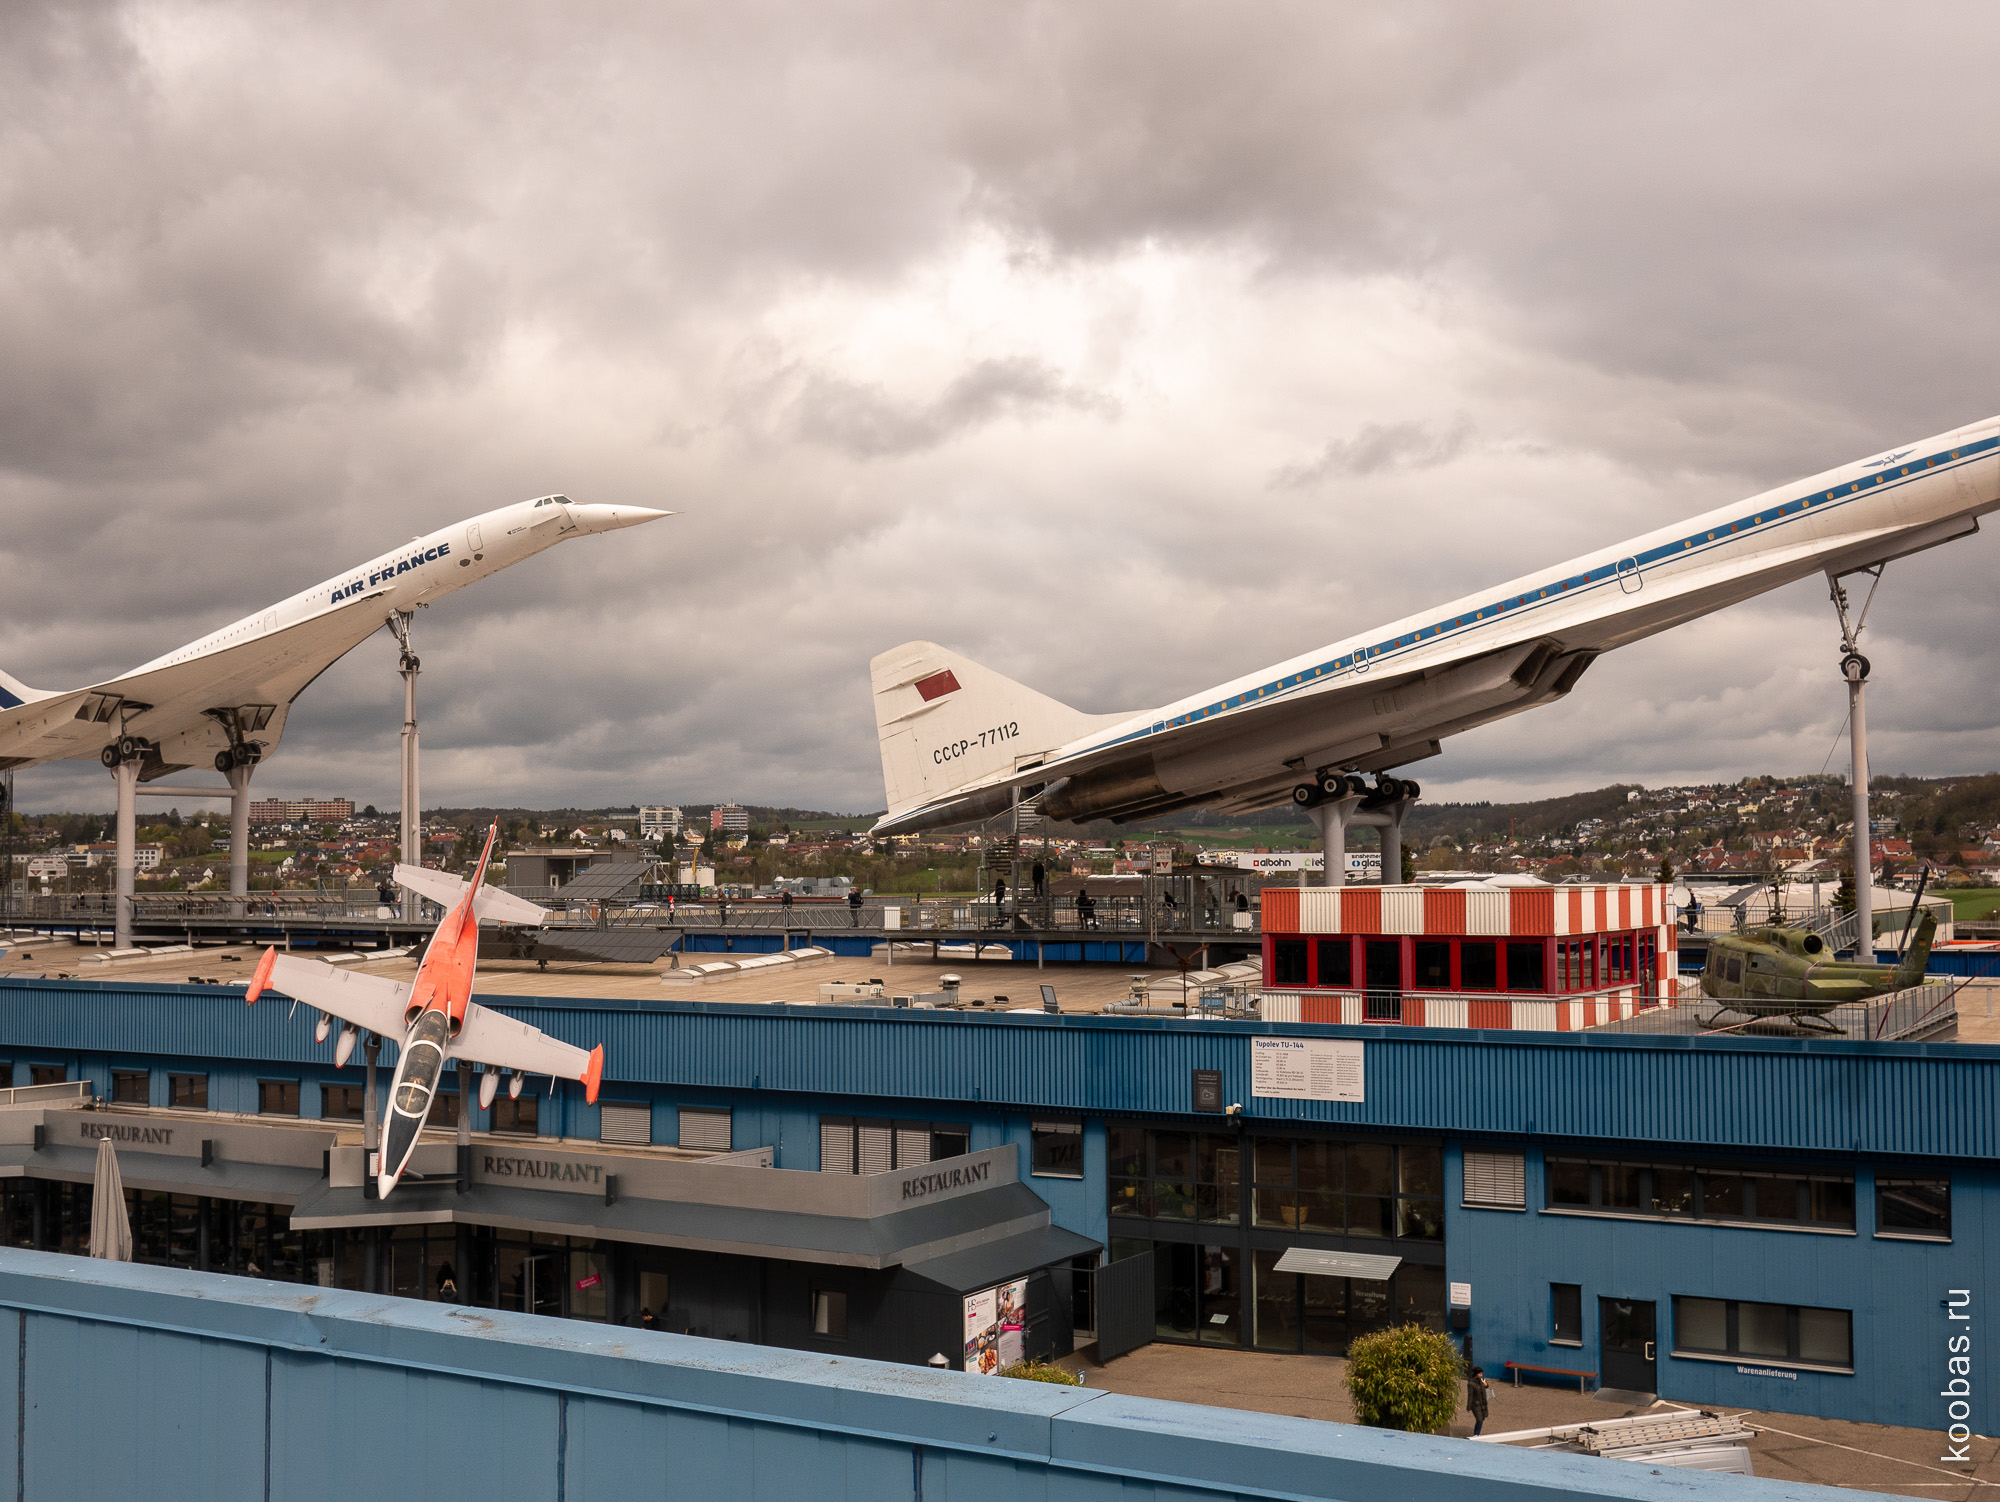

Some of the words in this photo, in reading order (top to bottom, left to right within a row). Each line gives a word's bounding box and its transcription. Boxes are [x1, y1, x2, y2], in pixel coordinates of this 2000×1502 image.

[331, 580, 365, 605] AIR
[368, 542, 451, 588] FRANCE
[1260, 858, 1292, 867] albohn
[1255, 1040, 1280, 1048] Tupolev
[1281, 1041, 1304, 1049] TU-144
[80, 1122, 173, 1145] RESTAURANT
[484, 1155, 603, 1184] RESTAURANT
[902, 1161, 992, 1200] RESTAURANT
[1354, 1290, 1387, 1301] Verwaltung
[1736, 1365, 1797, 1381] Warenanlieferung
